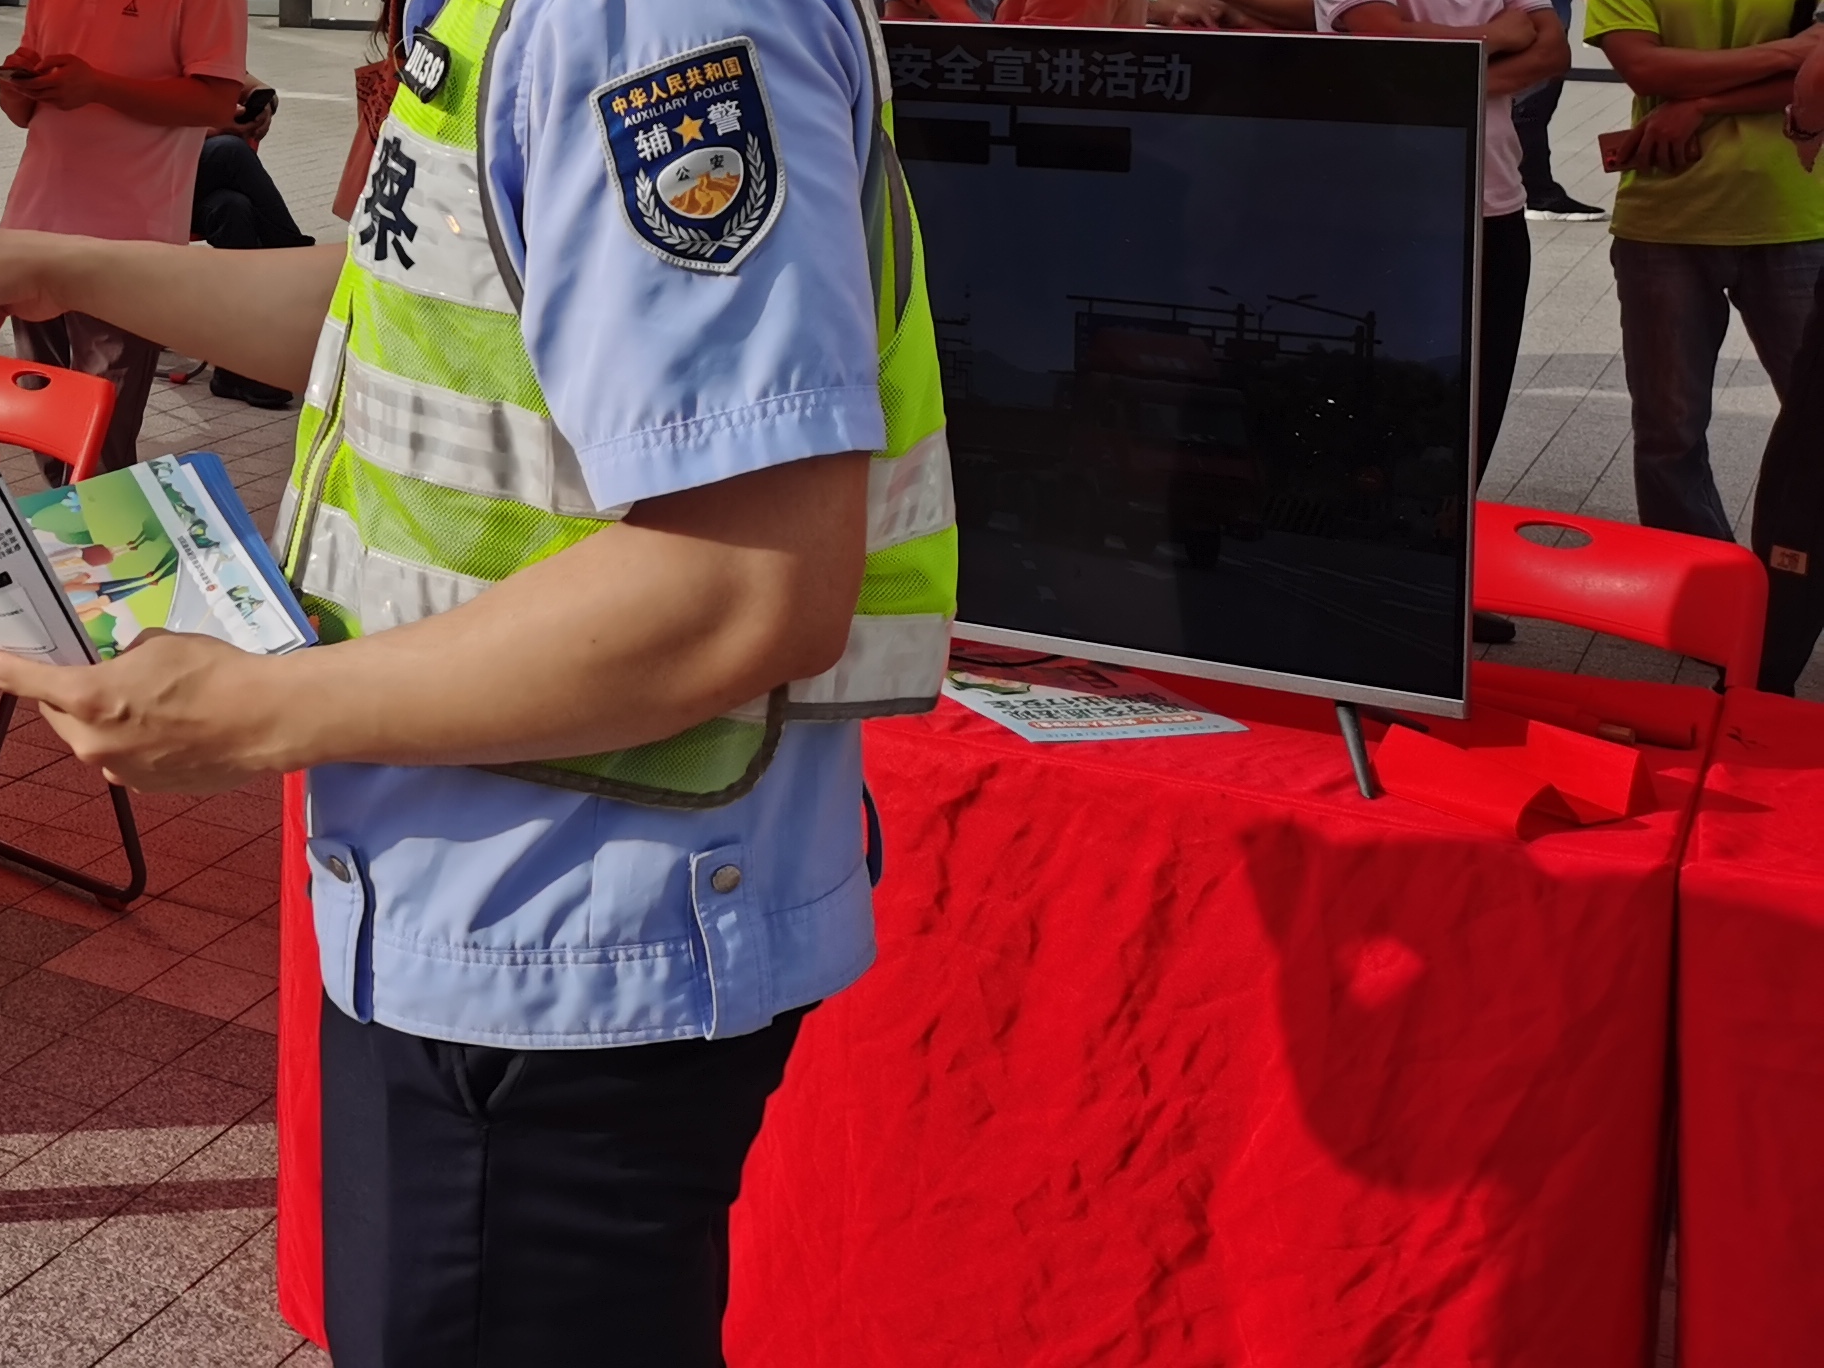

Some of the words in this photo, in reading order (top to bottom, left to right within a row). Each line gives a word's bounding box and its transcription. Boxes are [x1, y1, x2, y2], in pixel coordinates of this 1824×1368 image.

[611, 56, 743, 117] 中华人民共和国
[889, 43, 1192, 101] 安全宣讲活动
[624, 95, 688, 128] AUXILIARY
[694, 79, 741, 103] POLICE
